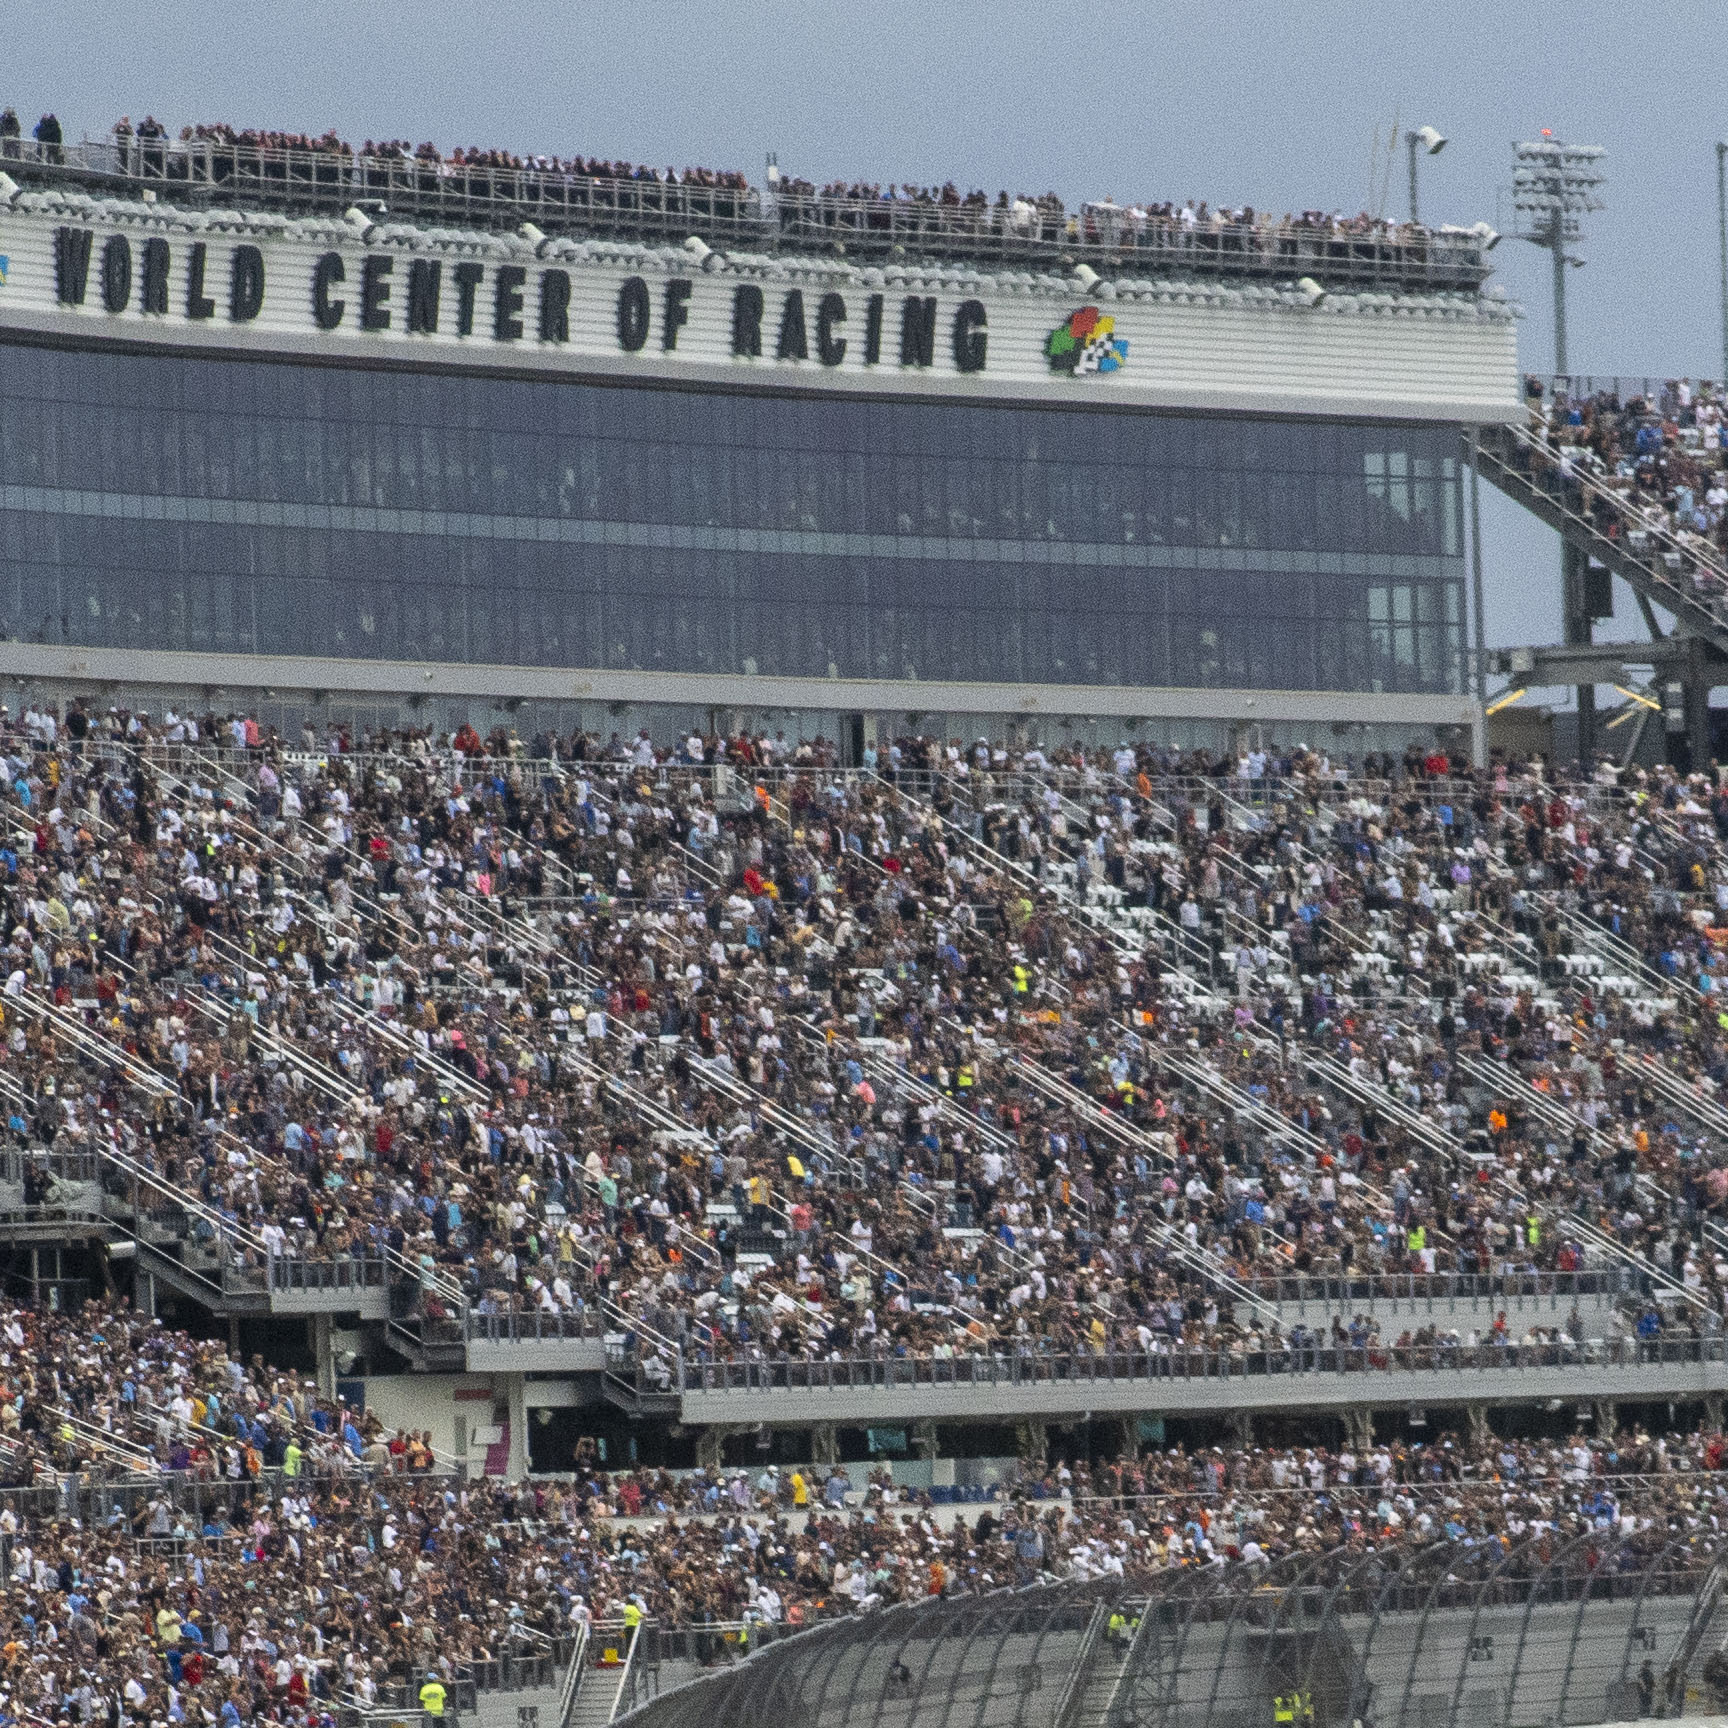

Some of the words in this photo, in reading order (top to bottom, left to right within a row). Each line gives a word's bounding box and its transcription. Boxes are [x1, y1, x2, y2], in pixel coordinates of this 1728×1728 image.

[57, 226, 265, 321] WORLD
[311, 251, 573, 344] CENTER
[616, 276, 694, 354] OF
[732, 284, 989, 373] RACING
